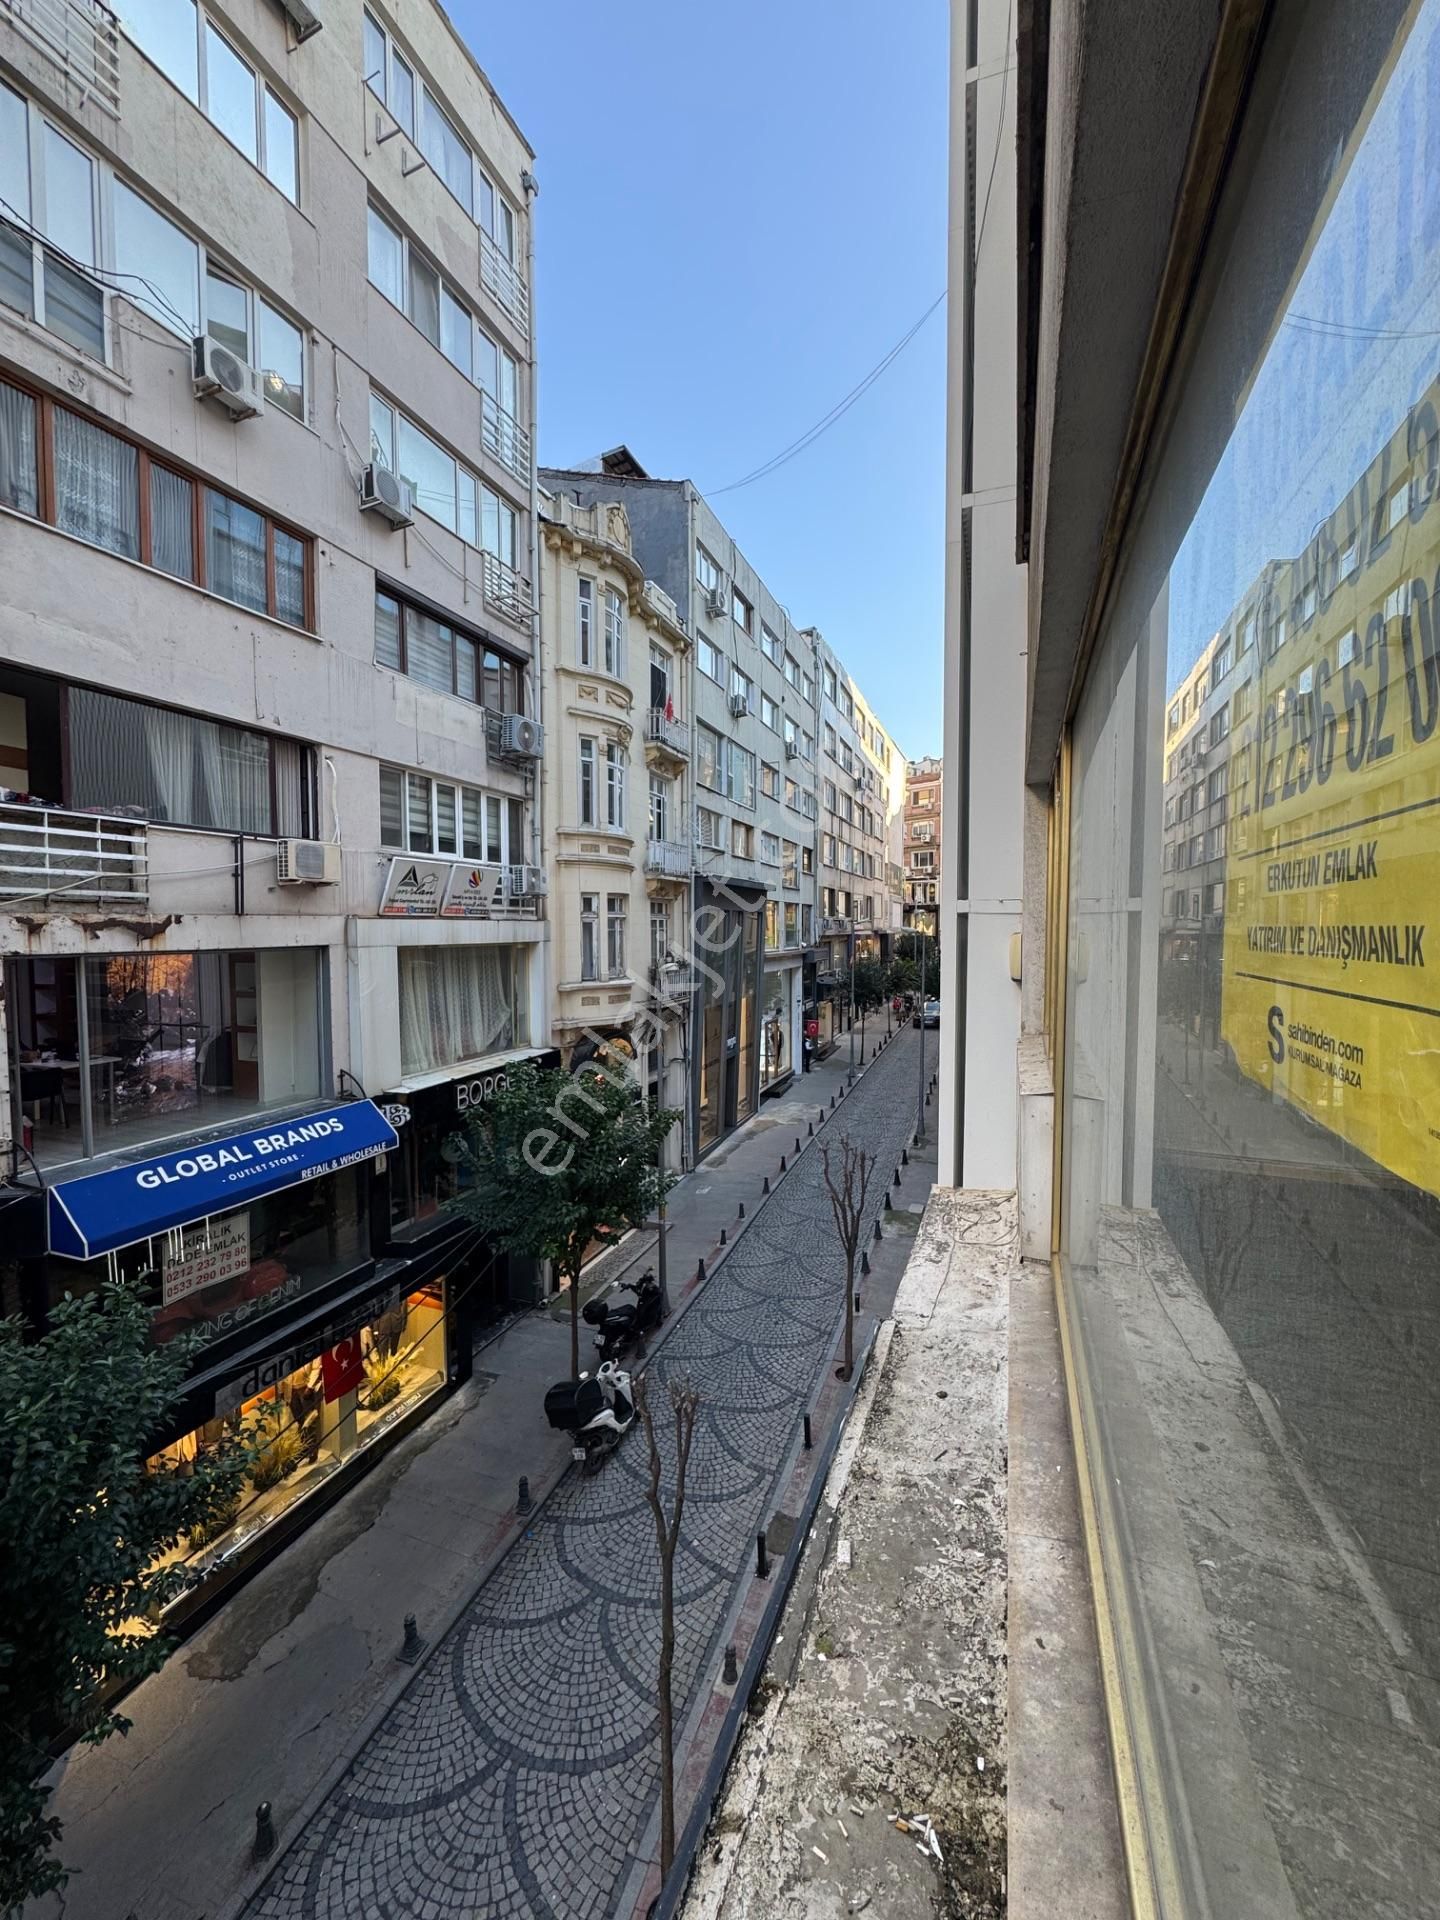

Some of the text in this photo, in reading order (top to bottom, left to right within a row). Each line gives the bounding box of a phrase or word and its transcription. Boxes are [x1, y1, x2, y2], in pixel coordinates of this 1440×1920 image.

[1401, 577, 1440, 744] 0
[1268, 840, 1379, 892] ERKUTUN EMLAK
[1247, 925, 1425, 970] YATIRIM VE DANIŞMANLIK
[1287, 1022, 1364, 1066] sahibinden.com
[1288, 1046, 1325, 1073] KURUMSAL
[136, 1117, 344, 1190] GLOBAL BRANDS
[228, 1153, 299, 1182] OUTLET STORE
[301, 1141, 387, 1180] RETAIL & WHOLESALE
[202, 1231, 246, 1256] EMLAK
[166, 1266, 193, 1285] 0212
[196, 1256, 217, 1272] 232
[220, 1251, 231, 1263] 79
[166, 1257, 247, 1299] 0533 290 03 96
